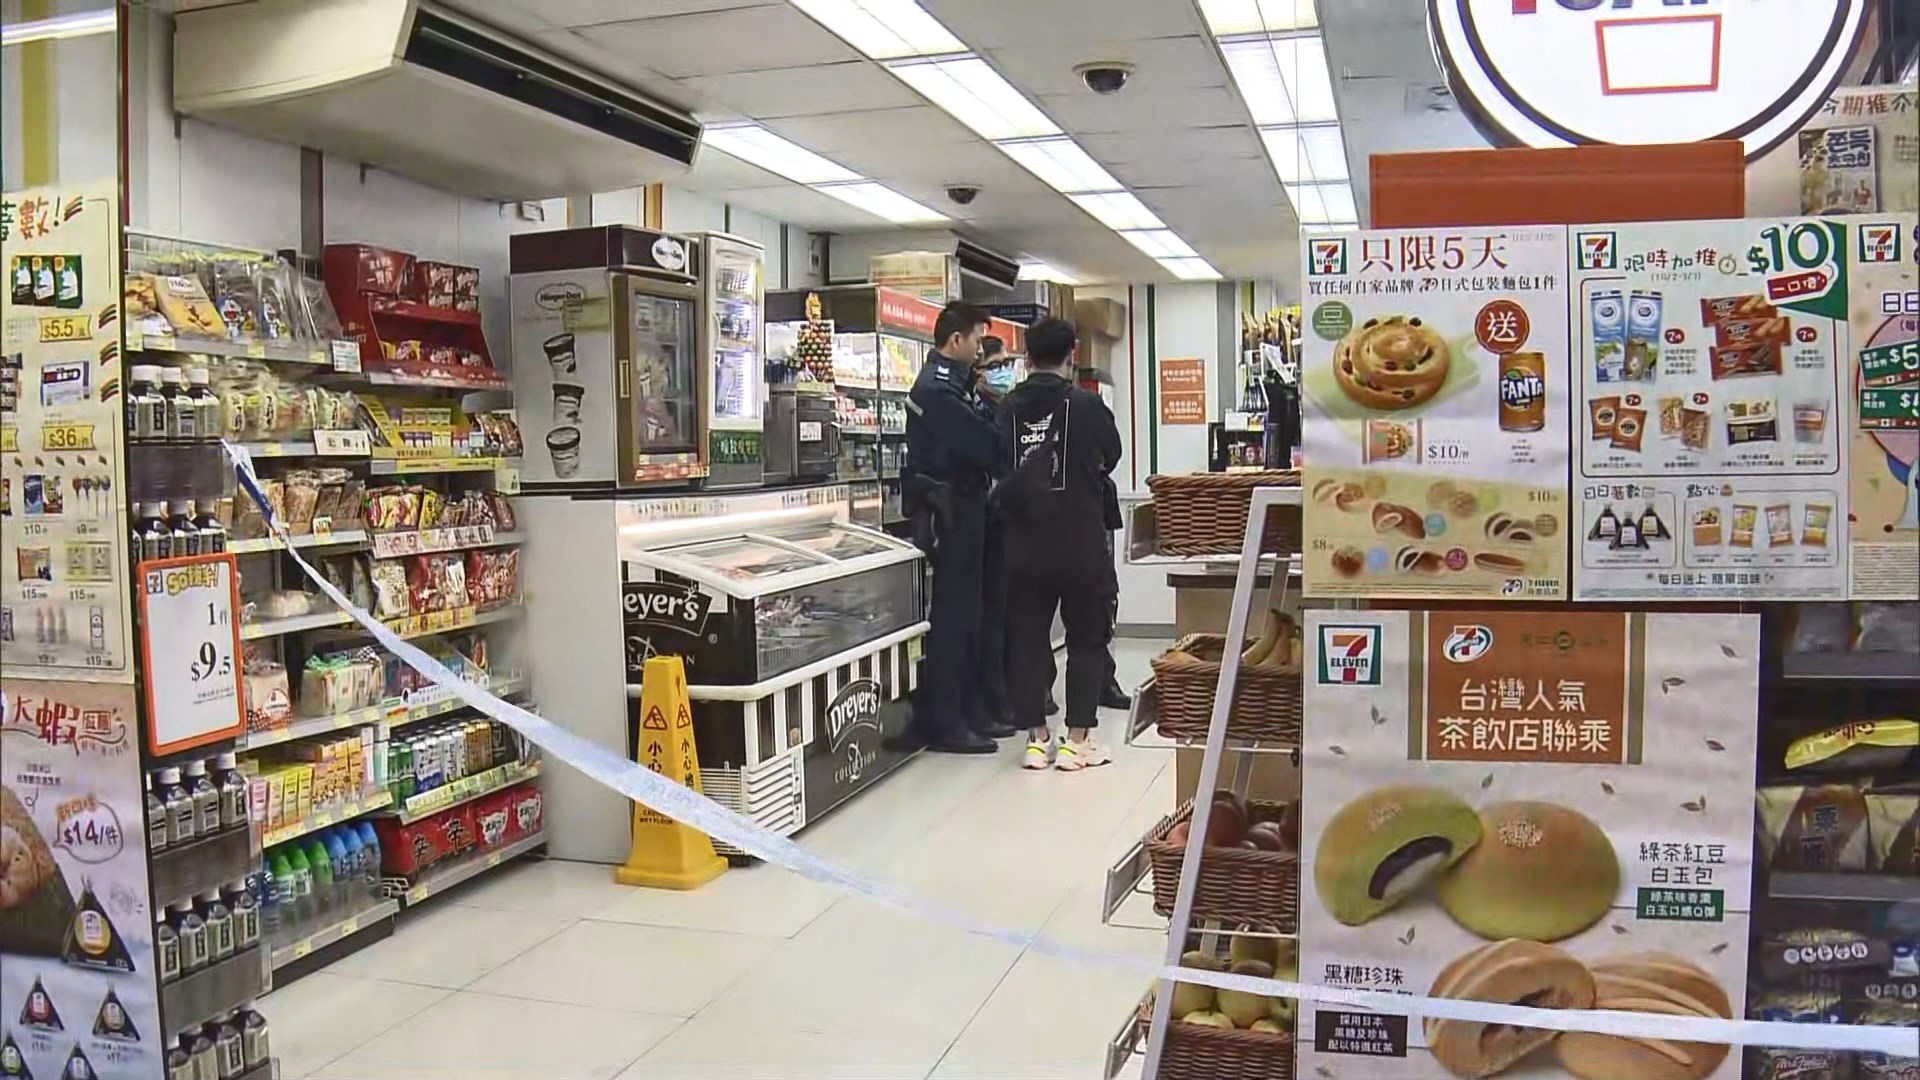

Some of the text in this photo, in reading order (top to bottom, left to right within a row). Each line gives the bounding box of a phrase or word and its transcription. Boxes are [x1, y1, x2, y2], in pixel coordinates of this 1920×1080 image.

[1360, 233, 1508, 272] 只限5天
[1624, 248, 1716, 272] 限時加推
[1747, 223, 1829, 274] $10
[1487, 311, 1518, 343] 送
[1502, 376, 1544, 398] FANTA
[1020, 431, 1046, 444] adid
[624, 592, 700, 621] eyer's
[191, 641, 231, 682] $9.5
[1461, 678, 1587, 712] 台灣人氣
[830, 691, 877, 738] Dreyer's
[1438, 717, 1611, 753] 茶飲店聯乘
[1640, 841, 1726, 863] 綠茶紅豆
[1652, 865, 1712, 885] 白玉包
[1324, 964, 1403, 985] 黑糖珍珠
